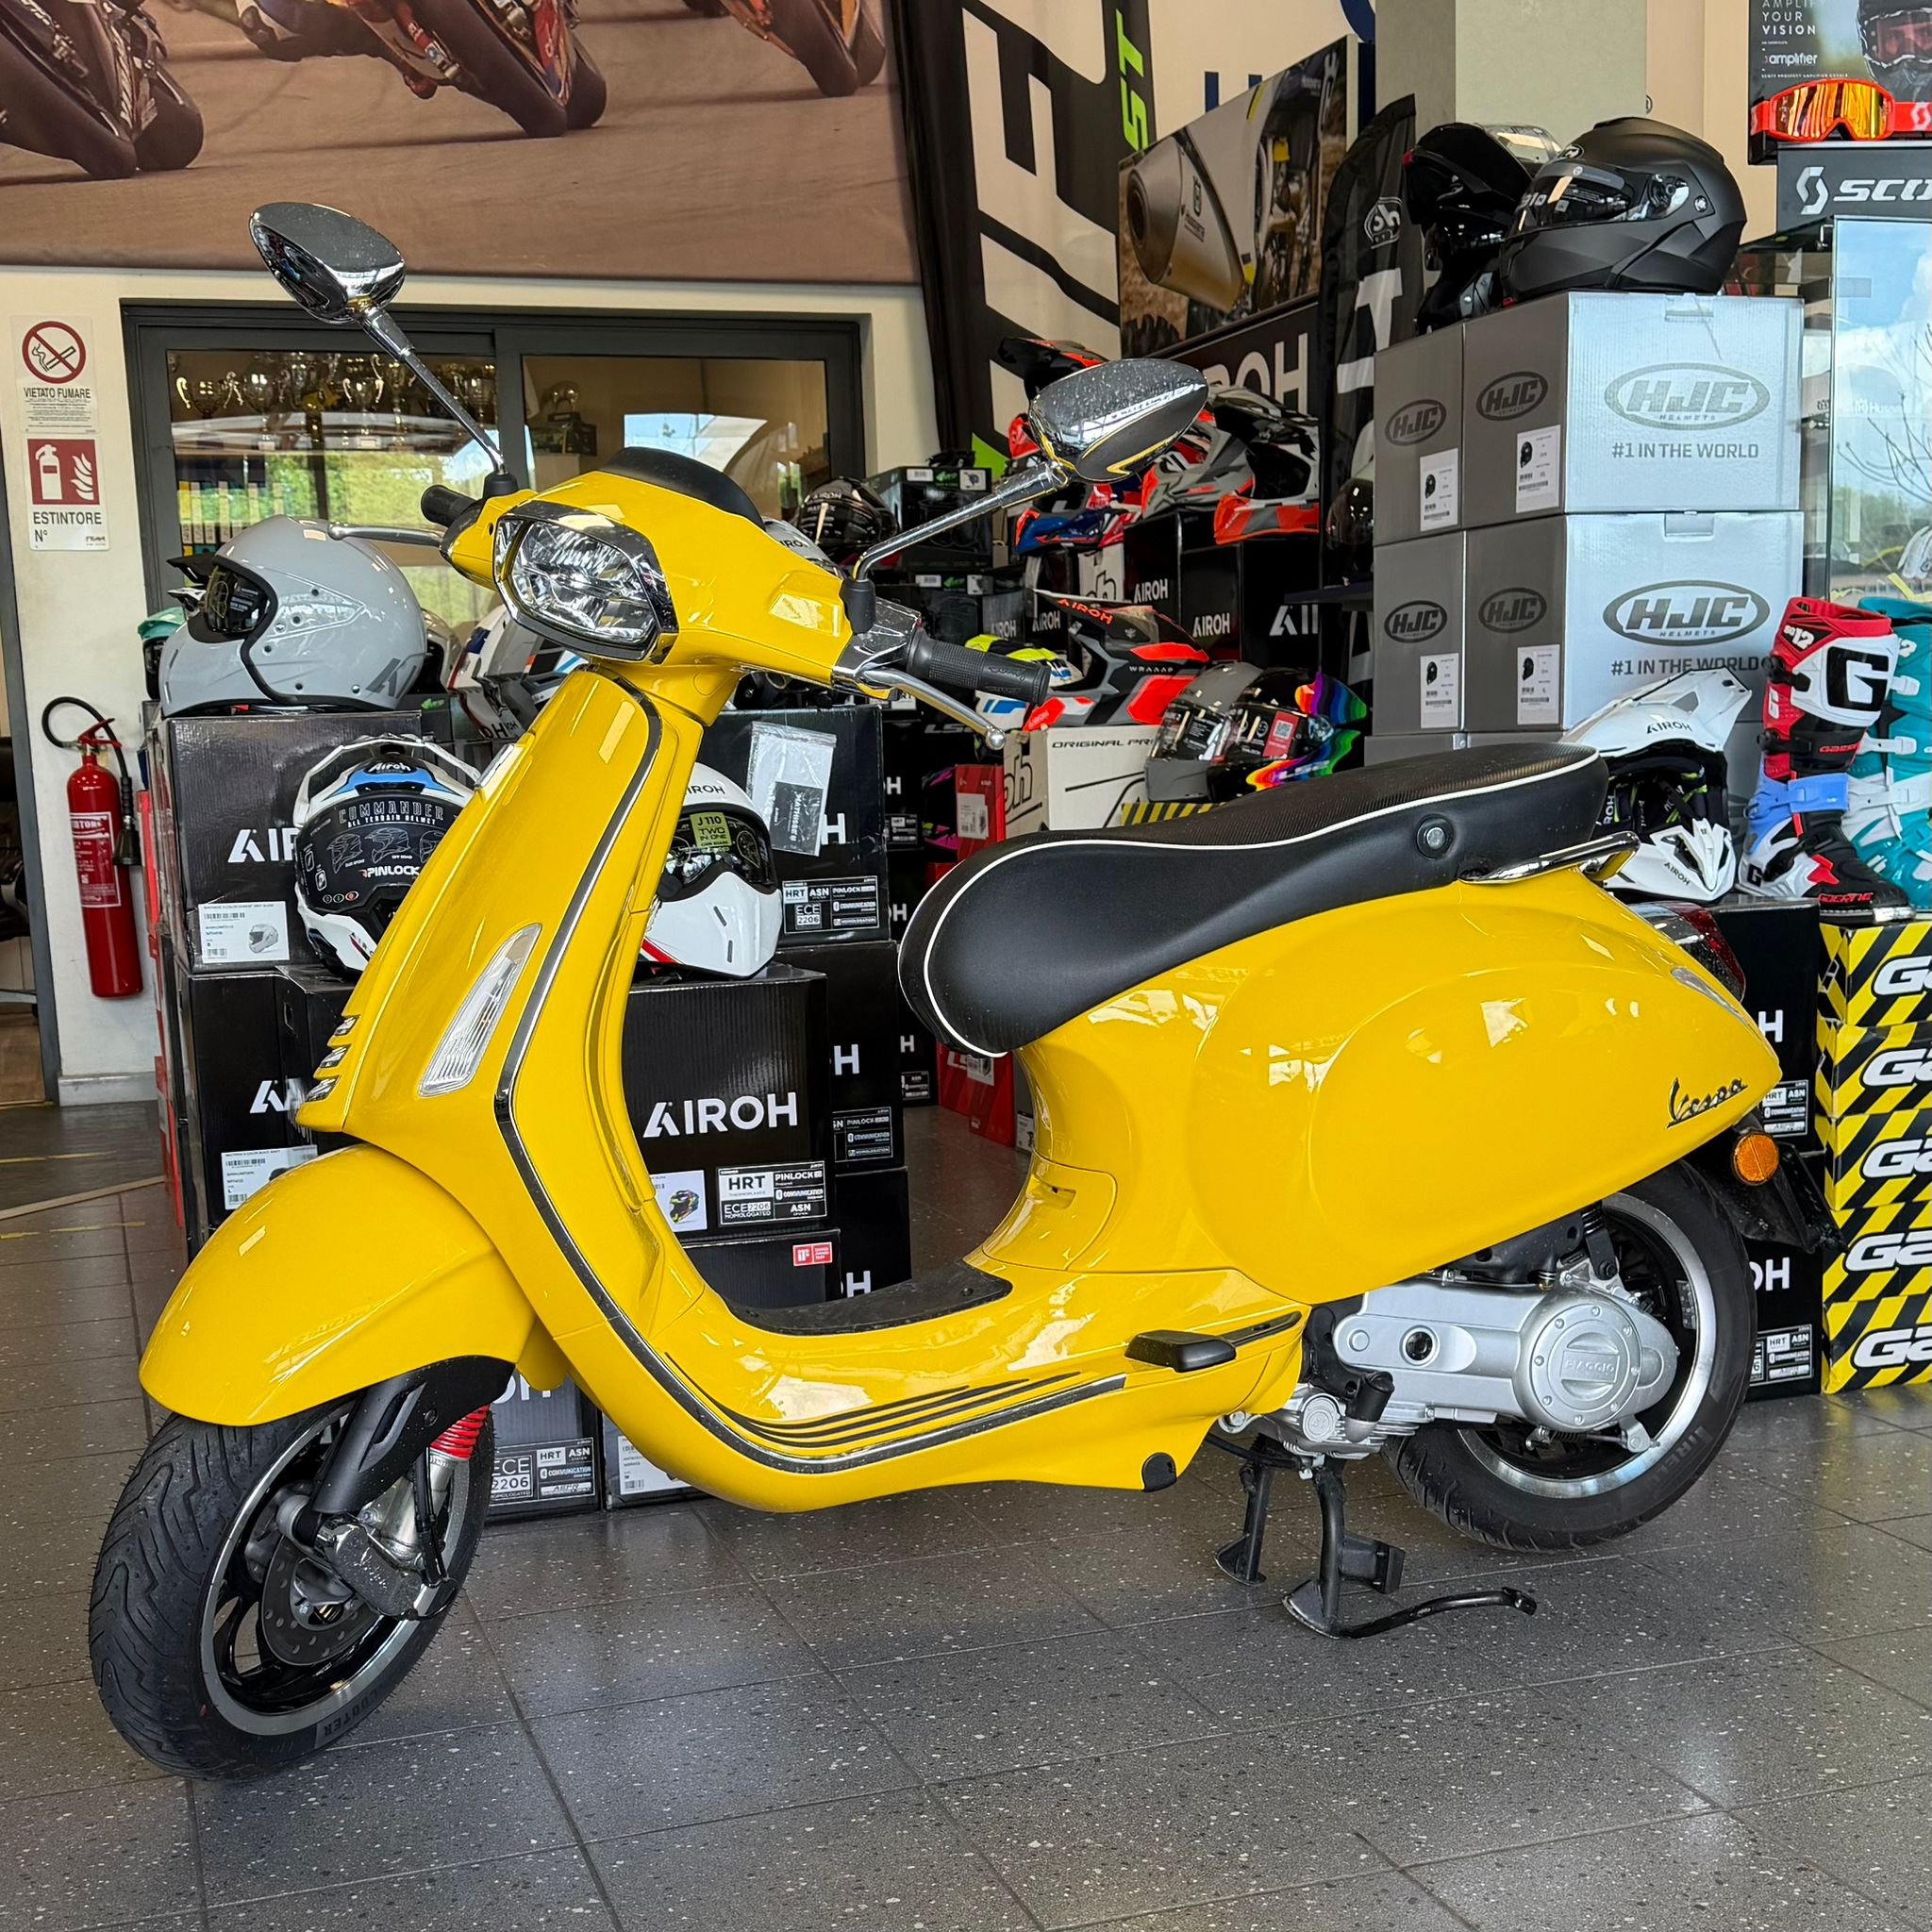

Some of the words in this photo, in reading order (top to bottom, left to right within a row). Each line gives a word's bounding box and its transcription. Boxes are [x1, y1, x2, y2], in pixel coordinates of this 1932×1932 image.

[1762, 11, 1803, 22] YOUR
[1762, 25, 1816, 35] VISION
[1769, 52, 1818, 66] amplifier
[24, 388, 55, 399] VIETATO
[58, 388, 91, 399] FUMARE
[1485, 379, 1539, 413] HJC
[1625, 379, 1750, 413] HJC
[1392, 407, 1440, 440] HJC
[1612, 442, 1634, 458] #1
[1639, 443, 1655, 458] IN
[1658, 443, 1692, 458] THE
[1696, 443, 1758, 458] WORLD
[33, 511, 102, 525] ESTINTORE
[35, 529, 48, 542] N°
[1134, 578, 1168, 604] AIROH
[1057, 598, 1113, 625] AIROH
[1488, 597, 1539, 623] HJC
[1625, 597, 1750, 630] HJC
[1033, 610, 1061, 632] AIROH
[1192, 613, 1230, 638] AIROH
[1391, 610, 1440, 634] HJC
[1611, 660, 1633, 675] #1
[1638, 660, 1655, 675] IN
[1658, 659, 1692, 675] THE
[1696, 657, 1757, 671] WORLD
[1827, 646, 1889, 712] G
[1646, 721, 1692, 735] AIROH
[1052, 739, 1124, 749] ORIGINAL
[686, 785, 726, 794] IROH
[339, 801, 444, 824] COMMANDER
[347, 819, 361, 828] ALL
[405, 814, 436, 825] HELMET
[706, 816, 722, 824] 110
[700, 827, 725, 836] TWO
[368, 865, 421, 878] PINLOCK
[1663, 861, 1690, 885] AIROH
[786, 890, 806, 898] HRT
[809, 888, 830, 897] ASN
[796, 905, 821, 915] ECE
[1788, 1089, 1806, 1098] ASN
[1665, 1077, 1748, 1129] Vespa
[642, 1092, 798, 1138] AIROH
[728, 1174, 766, 1191] HRT
[774, 1171, 813, 1182] PINLOCK
[724, 1203, 748, 1214] ECE
[748, 1201, 771, 1212] 2206
[790, 1204, 811, 1213] ASN
[1791, 1333, 1809, 1342] ASN
[1566, 1359, 1615, 1374] PIAGGIO
[540, 1450, 562, 1460] HRT
[568, 1447, 591, 1457] ASN
